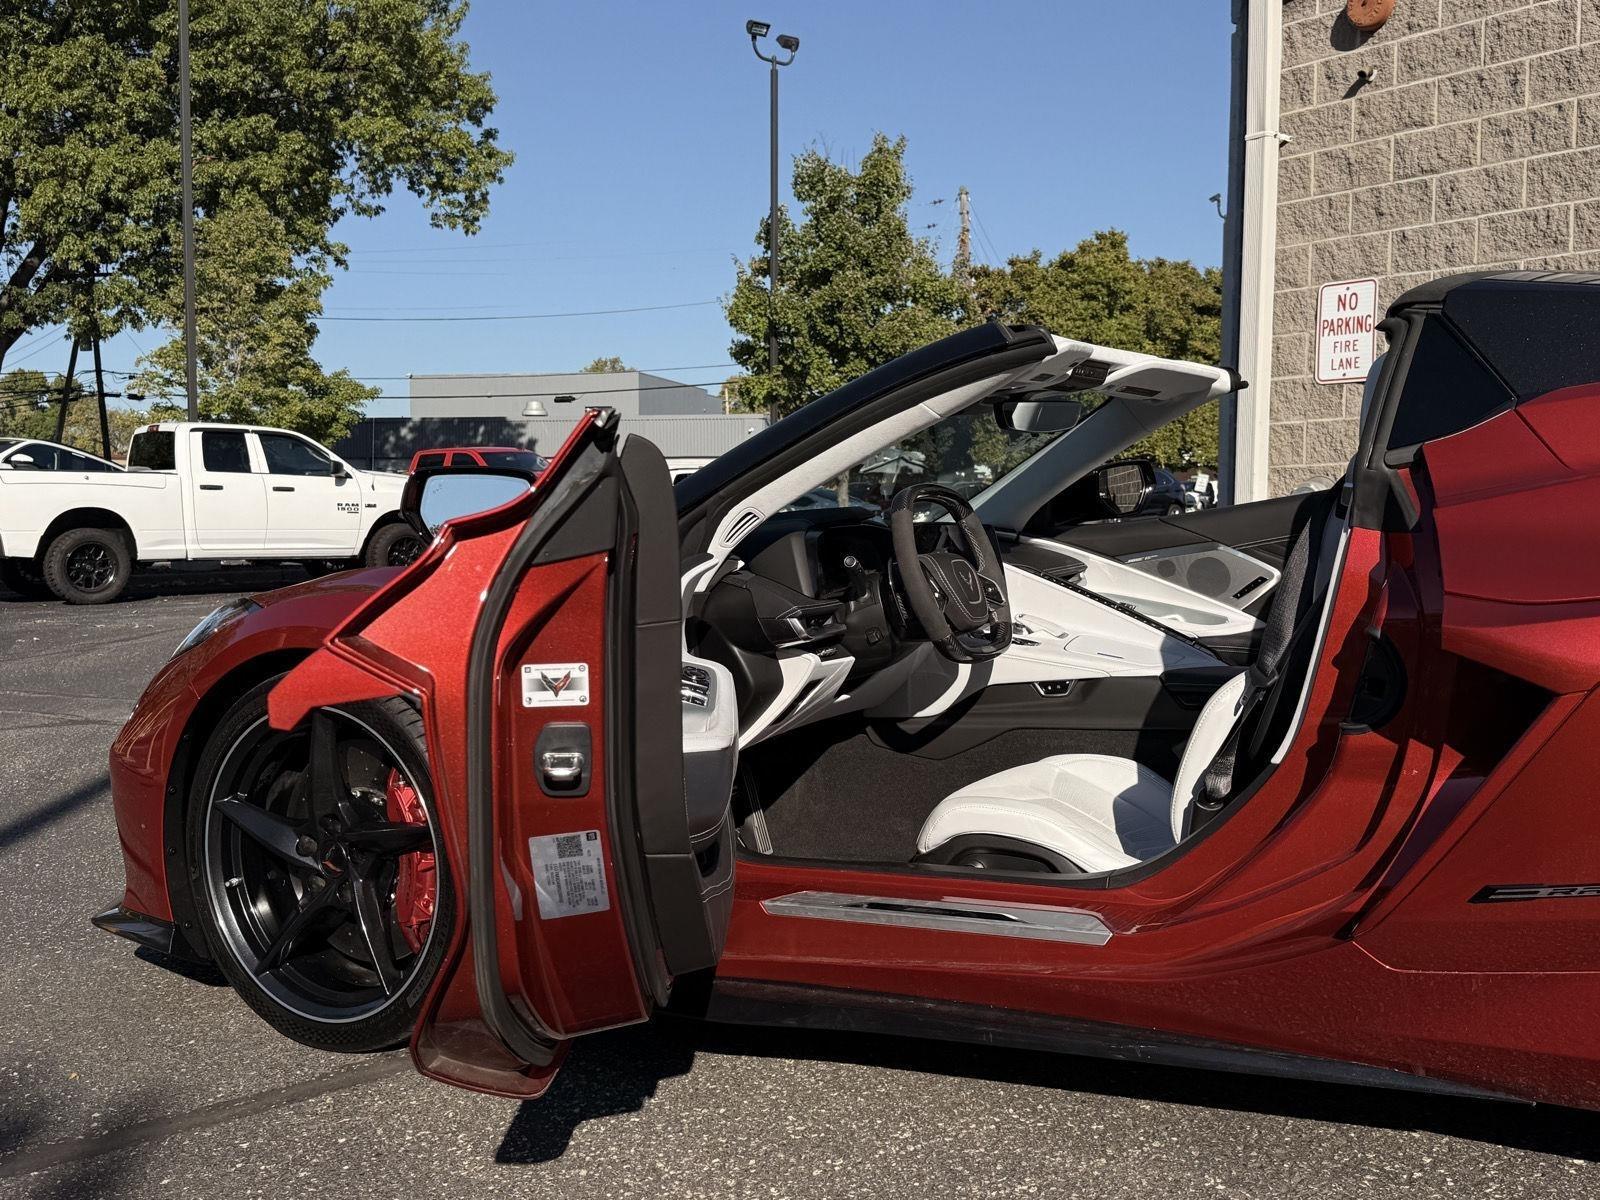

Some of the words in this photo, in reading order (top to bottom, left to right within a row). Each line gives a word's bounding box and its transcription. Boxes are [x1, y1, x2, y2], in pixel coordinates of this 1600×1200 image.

[1337, 292, 1358, 312] NO
[1322, 314, 1372, 337] PARKING
[1333, 340, 1359, 353] FIRE
[1331, 357, 1360, 371] LANE
